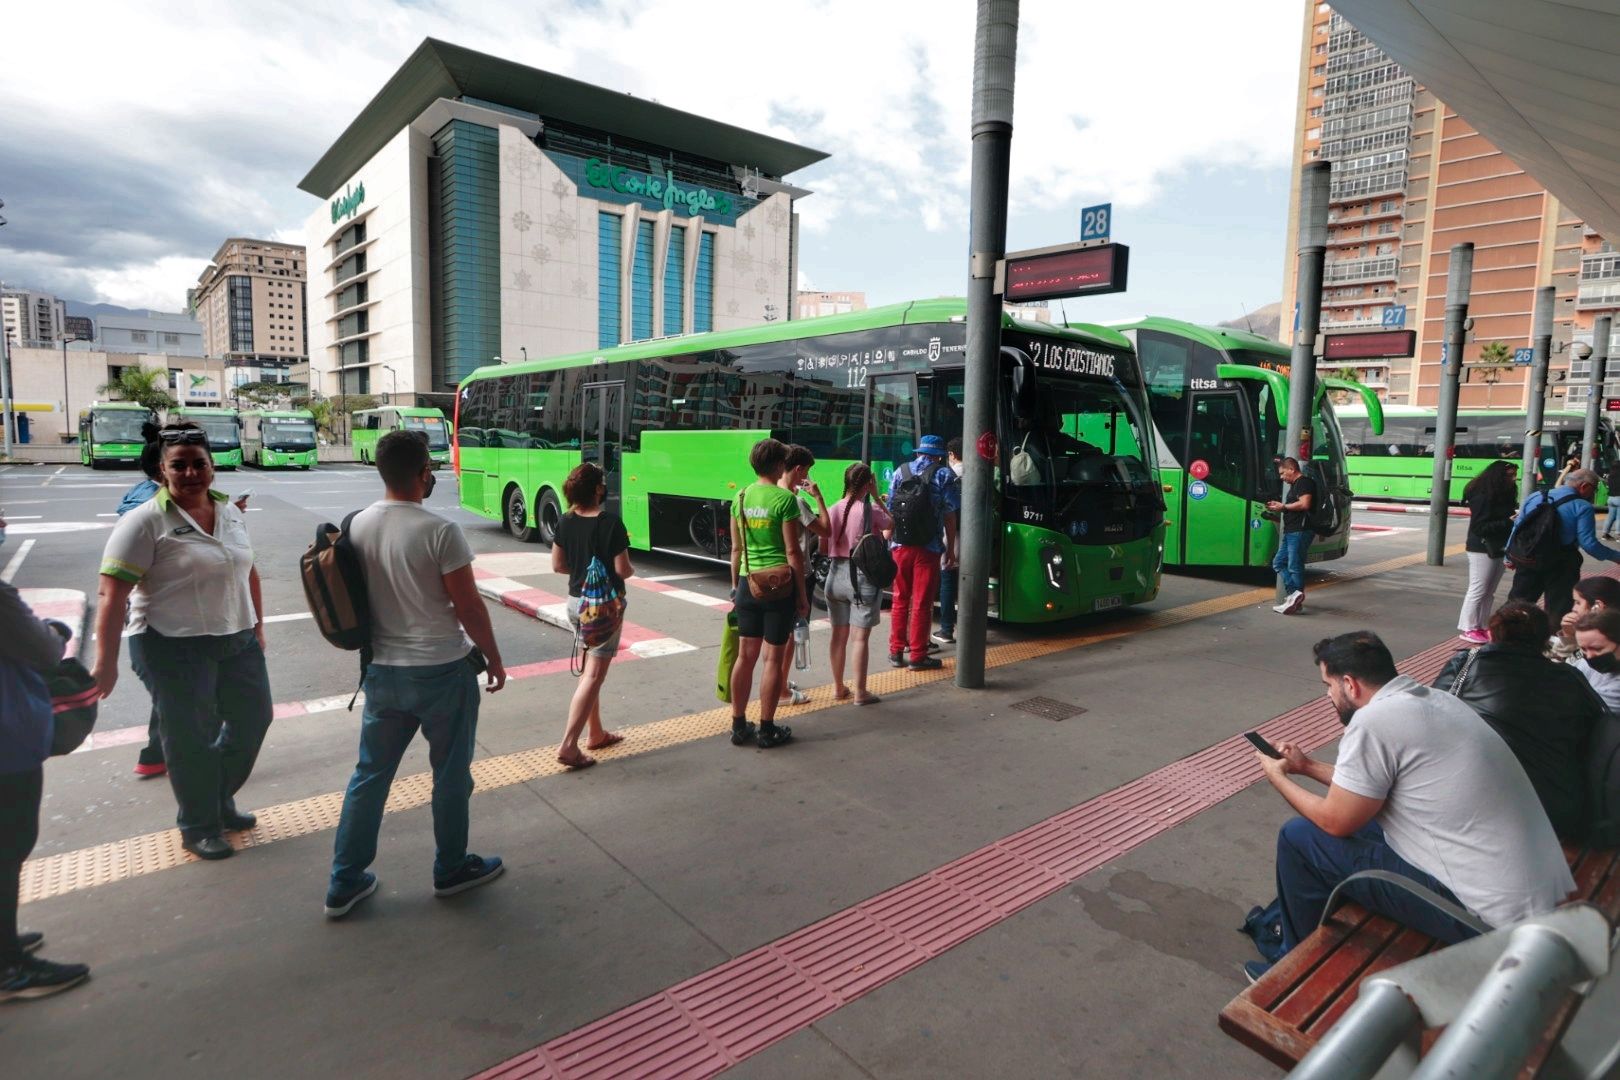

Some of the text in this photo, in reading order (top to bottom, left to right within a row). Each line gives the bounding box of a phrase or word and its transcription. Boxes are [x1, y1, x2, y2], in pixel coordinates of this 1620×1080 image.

[586, 157, 610, 188] El
[610, 165, 663, 199] Corte
[1084, 209, 1108, 237] 28
[1384, 308, 1404, 325] 27
[1043, 343, 1063, 370] LOS
[1064, 347, 1116, 377] CRISTIANOS
[1516, 350, 1531, 362] 26
[847, 366, 868, 388] 112
[1190, 378, 1217, 389] titsa
[1456, 463, 1473, 471] titsa
[1023, 510, 1044, 521] 9711
